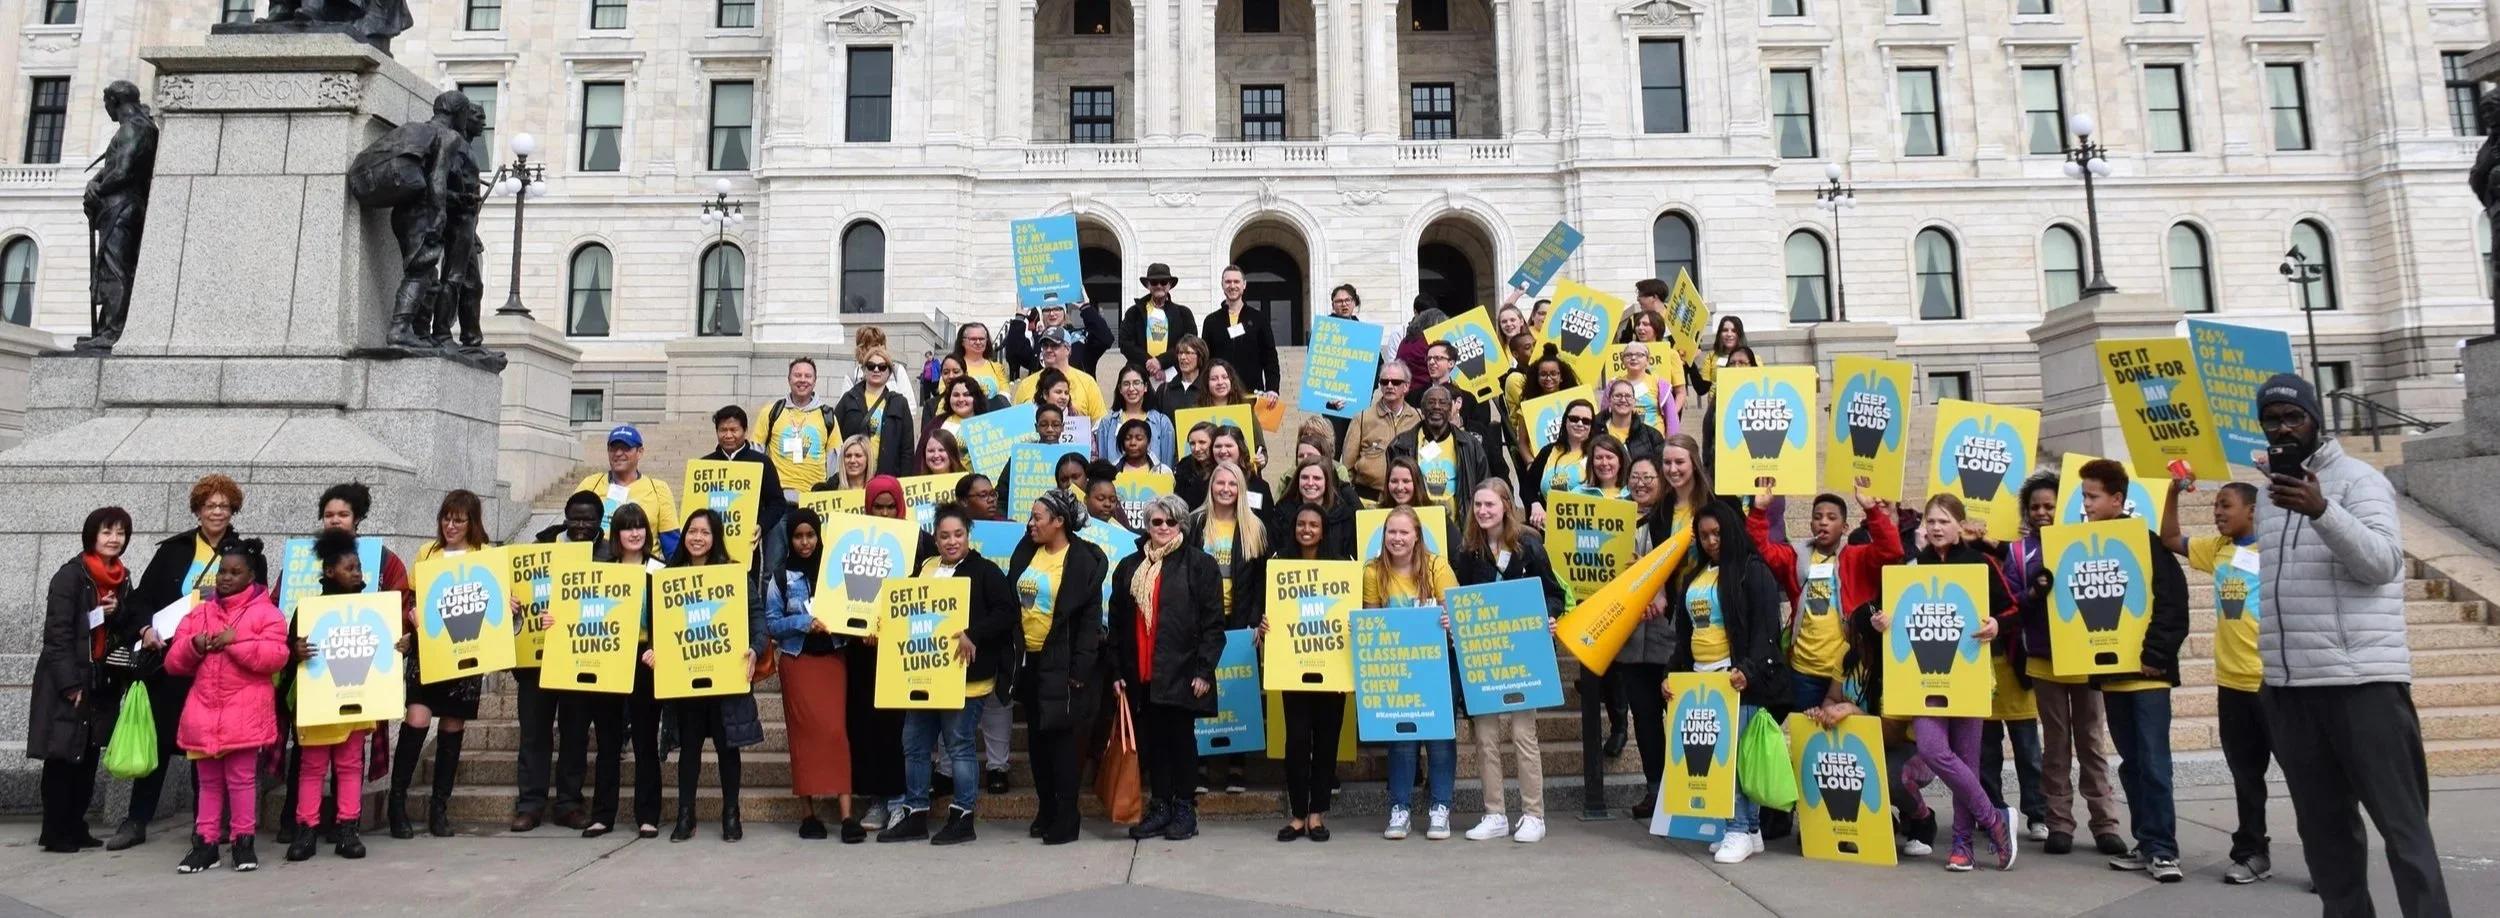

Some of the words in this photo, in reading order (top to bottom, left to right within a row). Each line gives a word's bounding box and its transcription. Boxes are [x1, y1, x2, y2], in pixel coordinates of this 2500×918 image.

[203, 79, 312, 101] OHNSON
[1031, 232, 1046, 242] MY
[1017, 240, 1074, 255] CLASSMATES
[1568, 307, 1600, 322] KEEP
[1561, 322, 1595, 340] LOUD
[1562, 312, 1600, 334] LUNGS
[1331, 334, 1348, 346] MY
[2196, 328, 2229, 346] 26%
[1314, 343, 1374, 362] CLASSMATES
[1648, 355, 1662, 366] OR
[2108, 351, 2133, 368] GET
[2135, 348, 2150, 364] IT
[2199, 346, 2217, 360] OF
[2222, 350, 2245, 364] MY
[2114, 366, 2153, 384] DONE
[2158, 360, 2186, 378] FOR
[1852, 392, 1888, 406] KEEP
[2143, 384, 2168, 401] MN
[1744, 398, 1787, 409] KEEP
[1846, 402, 1892, 420] LUNGS
[2210, 396, 2249, 416] CHEW
[1736, 408, 1794, 420] LUNGS
[2136, 402, 2192, 424] YOUNG
[1742, 419, 1789, 431] LOUD
[1848, 414, 1887, 430] LOUD
[2213, 413, 2234, 430] OR
[1062, 434, 1074, 443] 52
[2148, 421, 2200, 442] LUNGS
[1962, 434, 2008, 450] KEEP
[1954, 445, 2013, 463] LUNGS
[1958, 456, 2007, 474] LOUD
[693, 469, 714, 482] GET
[718, 467, 728, 479] IT
[693, 480, 724, 493] DONE
[728, 478, 750, 492] FOR
[905, 484, 918, 496] ET
[922, 481, 932, 493] IT
[710, 496, 728, 508] MN
[832, 497, 842, 510] IT
[906, 494, 930, 508] ONE
[1556, 502, 1580, 516] GET
[1584, 503, 1596, 517] IT
[1556, 517, 1592, 530] DONE
[1598, 518, 1624, 532] FOR
[1578, 535, 1600, 548] MN
[850, 544, 890, 557] KEEP
[512, 553, 536, 569] GET
[540, 550, 552, 564] IT
[842, 552, 894, 568] LUNGS
[1563, 552, 1616, 567] YOUNG
[2074, 558, 2120, 574] KEEP
[514, 566, 550, 584] DONE
[561, 572, 586, 586] GET
[592, 570, 603, 584] IT
[844, 564, 889, 578] LOUD
[1276, 570, 1302, 585] GET
[1306, 568, 1319, 582] IT
[1570, 568, 1616, 582] LUNGS
[2068, 570, 2128, 588] LUNGS
[442, 580, 482, 598] KEEP
[562, 586, 600, 600] DONE
[604, 584, 632, 598] FOR
[662, 576, 688, 594] GET
[692, 574, 704, 588] IT
[1278, 584, 1318, 600] DONE
[1322, 580, 1350, 598] FOR
[2073, 583, 2125, 600] LOUD
[436, 588, 490, 609] LUNGS
[664, 593, 703, 609] DONE
[708, 584, 735, 600] FOR
[890, 588, 913, 604] GET
[918, 586, 930, 600] IT
[1452, 592, 1484, 609] 26%
[2220, 592, 2246, 600] LOUD
[440, 601, 487, 619] LOUD
[582, 604, 605, 618] MN
[688, 608, 711, 622] MN
[890, 604, 926, 619] DONE
[932, 597, 958, 612] FOR
[1302, 602, 1324, 617] MN
[1454, 609, 1472, 624] OF
[1478, 606, 1500, 621] MY
[1912, 602, 1958, 616] KEEP
[566, 620, 620, 638] YOUNG
[912, 620, 933, 635] MN
[1286, 618, 1342, 638] YOUNG
[1356, 616, 1387, 631] 26%
[1458, 616, 1544, 638] CLASSMATES
[1593, 606, 1626, 640] GENERATION
[1904, 614, 1966, 628] LUNGS
[328, 624, 372, 637] KEEP
[674, 622, 729, 646] YOUNG
[1356, 632, 1374, 646] OF
[1379, 631, 1400, 646] MY
[1910, 627, 1961, 642] LOUD
[320, 634, 380, 650] LUNGS
[572, 636, 621, 654] LUNGS
[682, 638, 732, 662] LUNGS
[897, 636, 949, 656] YOUNG
[1294, 635, 1344, 654] LUNGS
[1460, 636, 1516, 654] SMOKE,
[326, 646, 376, 660] LOUD
[1358, 645, 1442, 662] CLASSMATES
[1464, 652, 1504, 669] CHEW
[904, 652, 950, 672] LUNGS
[1215, 665, 1252, 680] MATES
[1360, 662, 1413, 680] SMOKE,
[1466, 670, 1486, 684] OR
[1490, 664, 1532, 681] VAPE.
[1361, 678, 1399, 694] CHEW
[1482, 679, 1542, 692] #KeepLungsLoud
[1362, 695, 1382, 709] OR
[1386, 692, 1426, 708] VAPE.
[1375, 710, 1435, 720] #KeepLungsLoud
[1686, 708, 1716, 720] KEEP
[1680, 720, 1721, 733] LUNGS
[1682, 732, 1717, 745] LOUD
[1816, 751, 1858, 765] KEEP
[1812, 762, 1866, 778] LUNGS
[1817, 776, 1862, 790] LOUD
